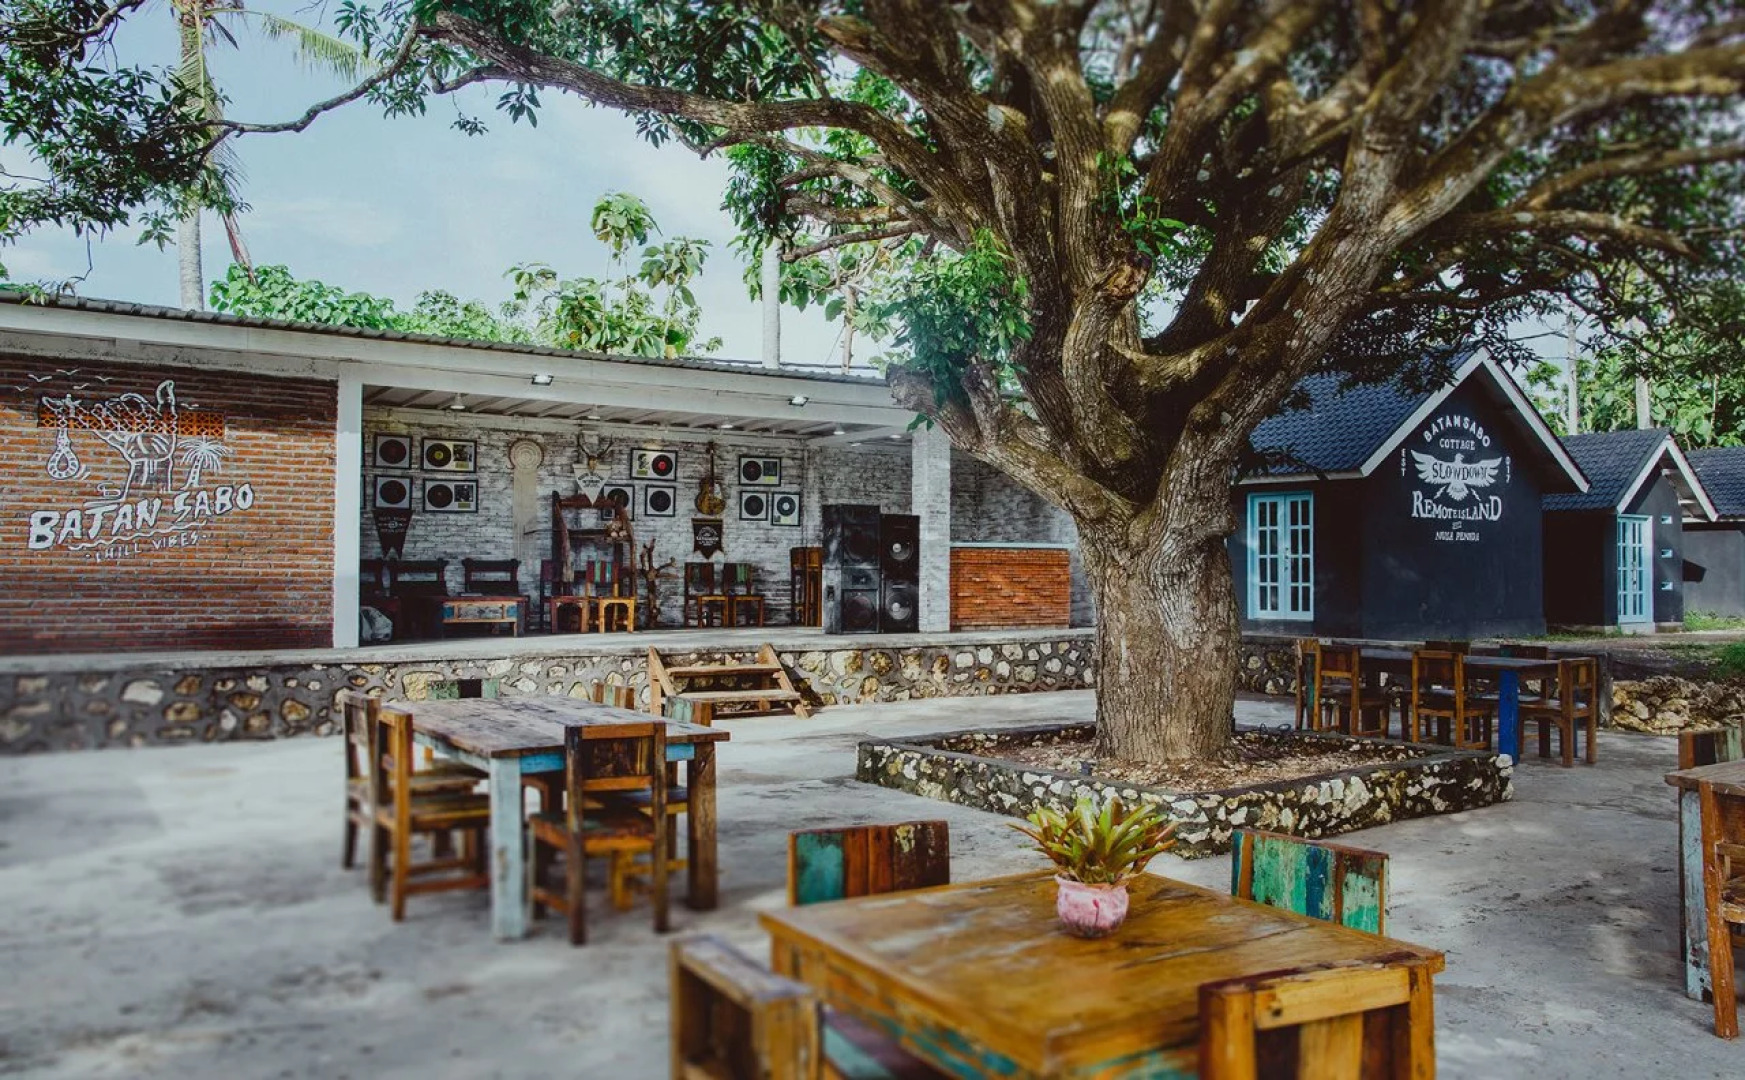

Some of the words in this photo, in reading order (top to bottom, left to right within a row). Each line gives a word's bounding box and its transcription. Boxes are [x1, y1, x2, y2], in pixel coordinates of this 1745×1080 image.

[1439, 438, 1476, 451] COTTAGE
[28, 498, 162, 550] BATAN
[172, 483, 255, 523] SABO
[152, 530, 199, 550] VIBES
